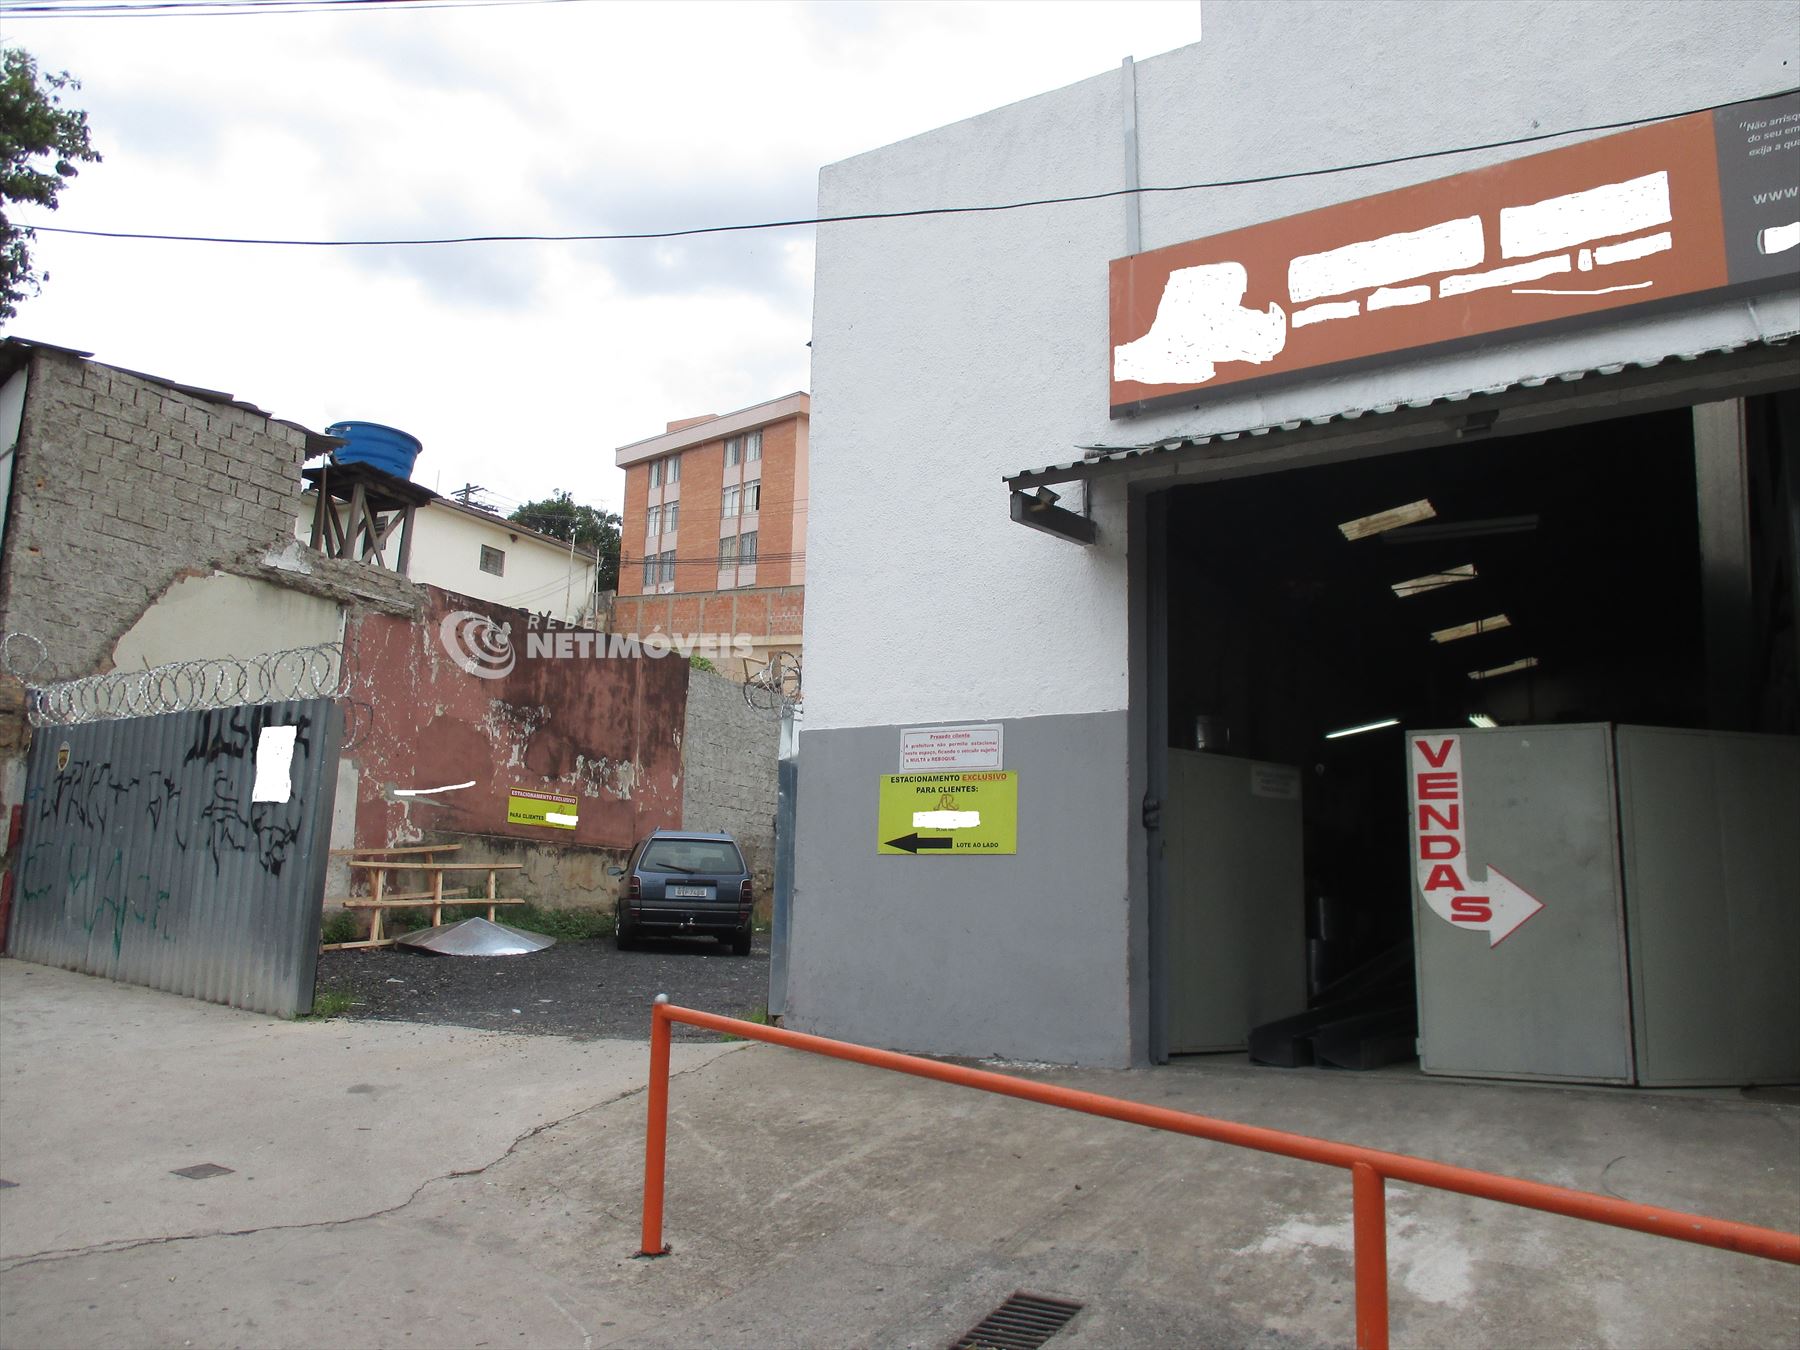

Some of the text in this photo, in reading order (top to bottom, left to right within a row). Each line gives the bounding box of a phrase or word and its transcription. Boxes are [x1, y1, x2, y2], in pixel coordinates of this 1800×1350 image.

[1747, 134, 1761, 143] do
[1763, 130, 1782, 139] seu
[1749, 145, 1772, 156] exija
[891, 774, 1008, 783] ESTACIONAMENTO EXCLUSIVO
[916, 785, 979, 794] PARA CLIENTES:
[511, 790, 552, 800] ESTACIONAMENTO
[1415, 739, 1493, 923] VENDAS
